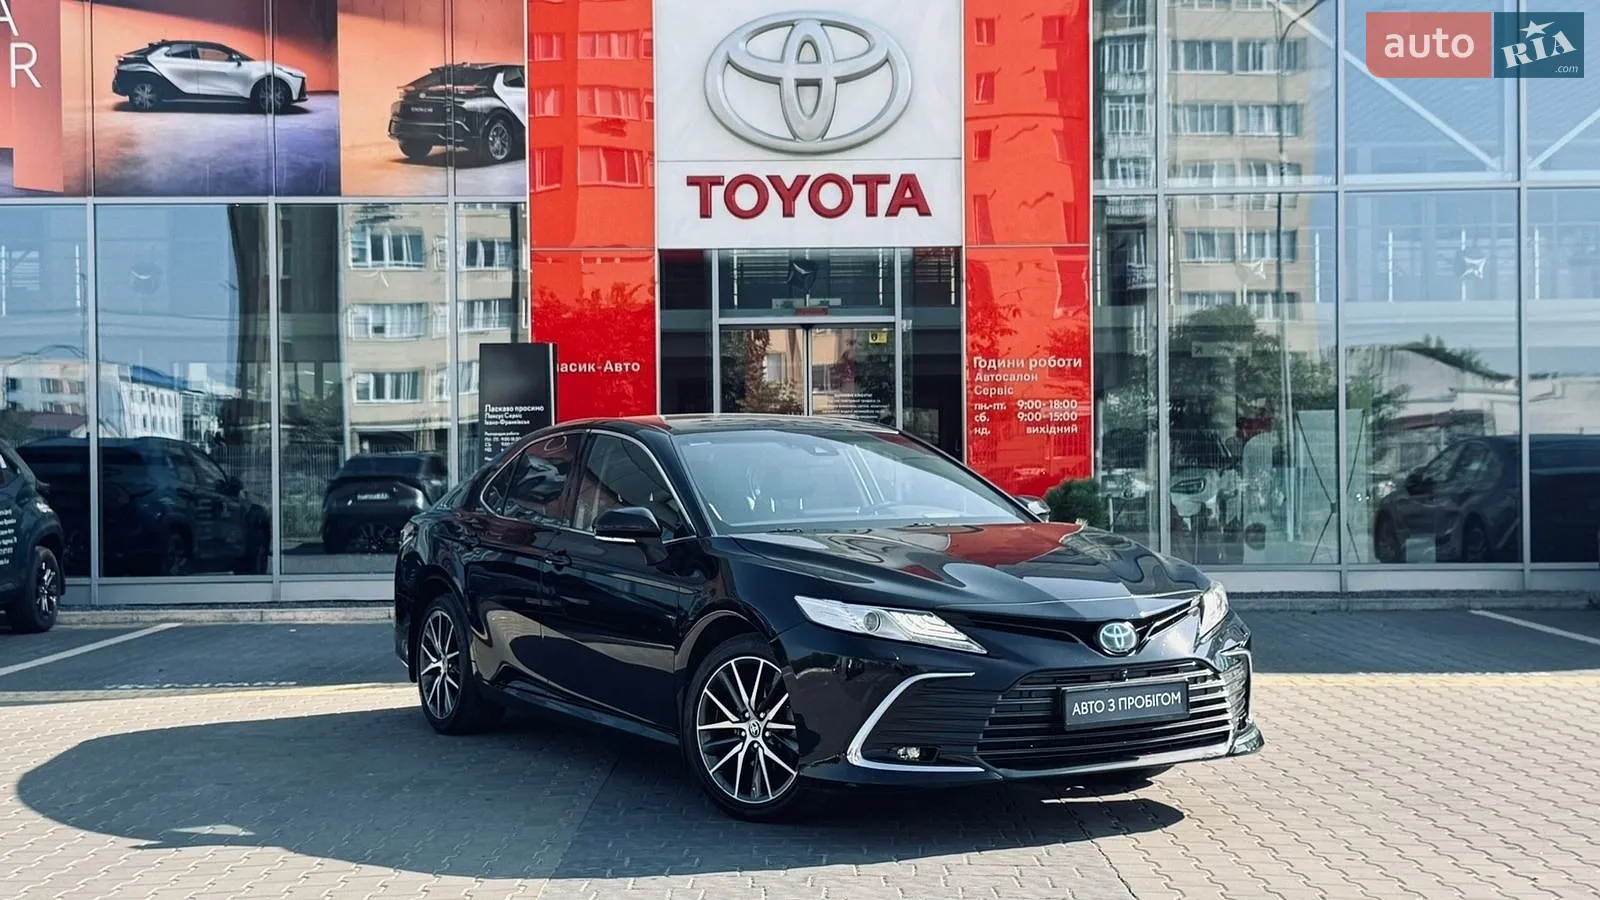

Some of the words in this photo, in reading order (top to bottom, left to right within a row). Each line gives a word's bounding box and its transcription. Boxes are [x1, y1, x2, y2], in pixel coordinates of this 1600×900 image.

[686, 172, 933, 220] TOYOTA
[973, 356, 1025, 370] Години
[1028, 356, 1082, 370] роботи
[974, 372, 1038, 382] Автосалон
[974, 385, 1014, 397] Сервіс
[1026, 424, 1078, 435] вихідний
[1072, 699, 1106, 717] АВТО
[1118, 691, 1182, 711] ПРОБІГОМ
